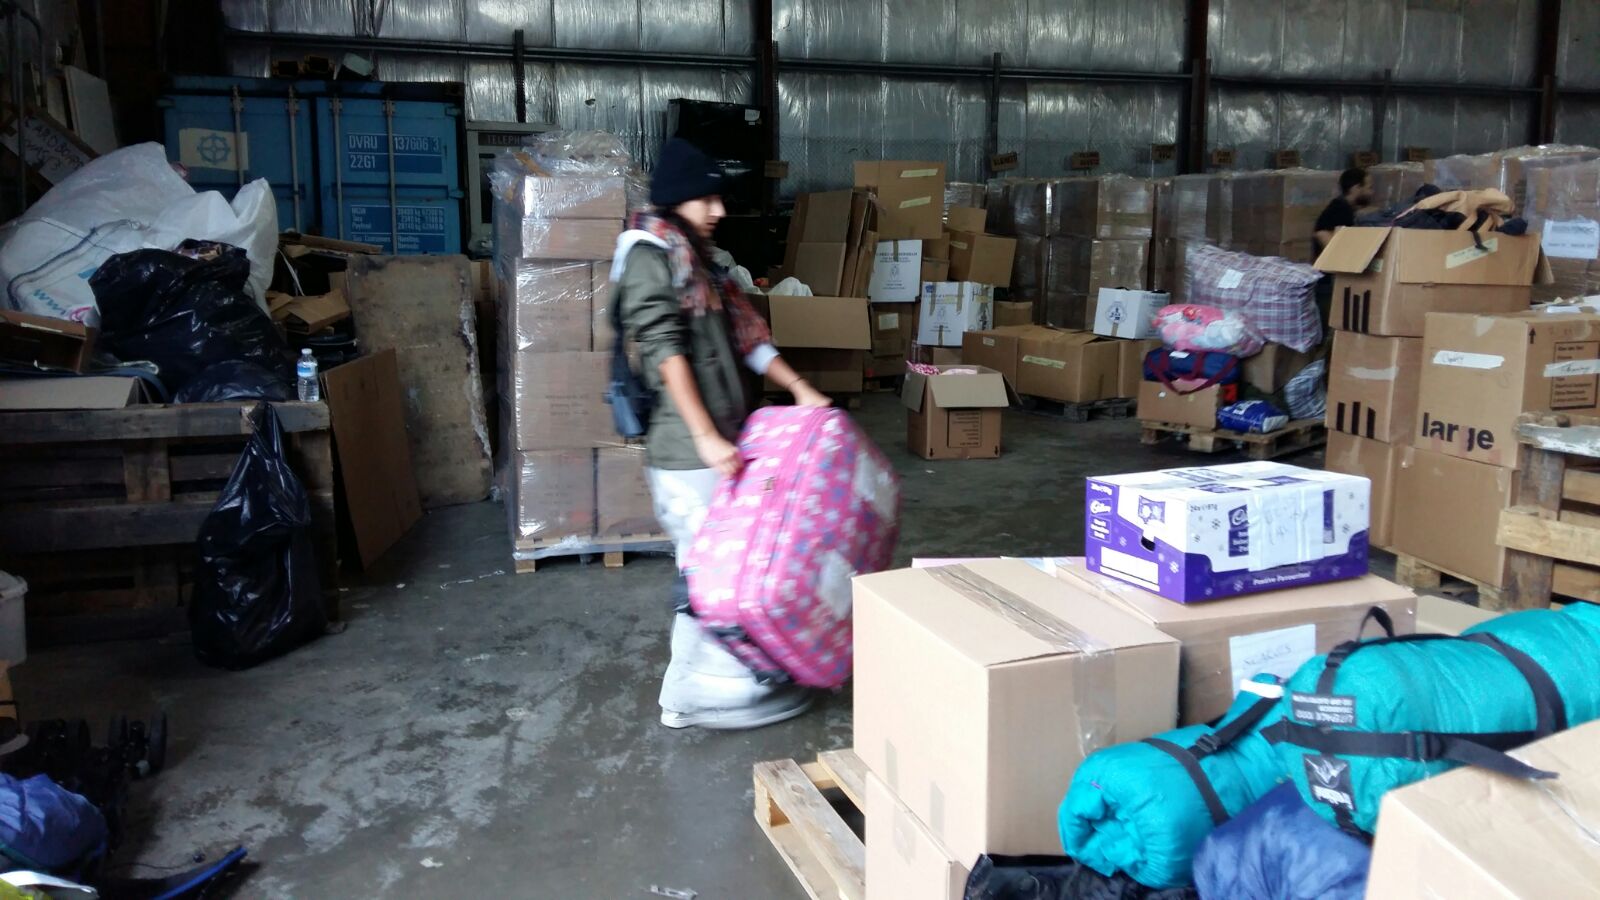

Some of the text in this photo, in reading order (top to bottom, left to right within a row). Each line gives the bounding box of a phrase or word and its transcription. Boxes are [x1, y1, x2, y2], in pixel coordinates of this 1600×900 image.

[348, 134, 439, 151] DVRU 137606 3
[487, 134, 521, 145] TELEPH
[350, 154, 376, 169] 22G1
